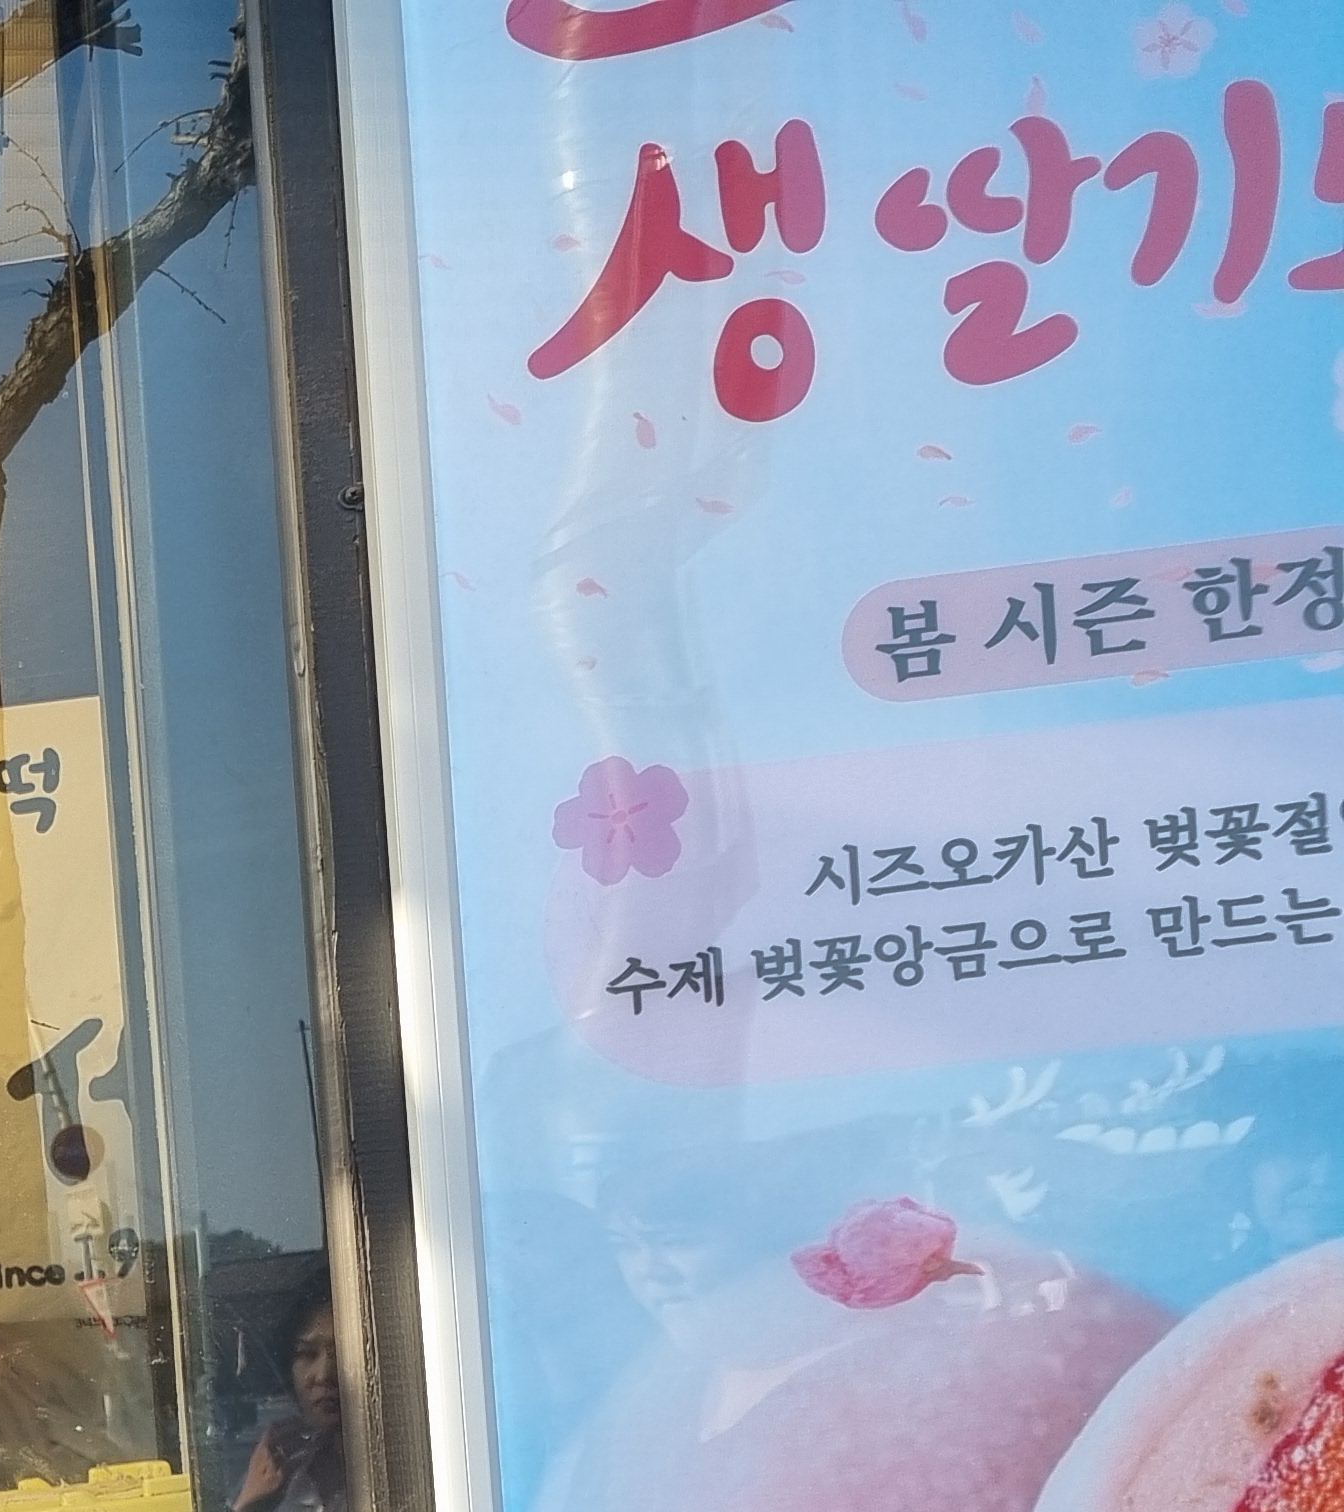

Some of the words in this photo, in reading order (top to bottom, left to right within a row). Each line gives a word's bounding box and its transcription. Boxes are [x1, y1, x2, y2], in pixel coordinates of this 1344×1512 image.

[527, 117, 827, 423] 생
[875, 600, 956, 684] 봄
[985, 578, 1155, 666] 시즌
[804, 816, 1120, 905] 시즈오카산
[1146, 791, 1344, 868] 벚꽃절
[606, 947, 726, 1015] 수제
[750, 911, 1127, 1000] 벚꽃앙금으로
[1147, 889, 1341, 957] 만드는
